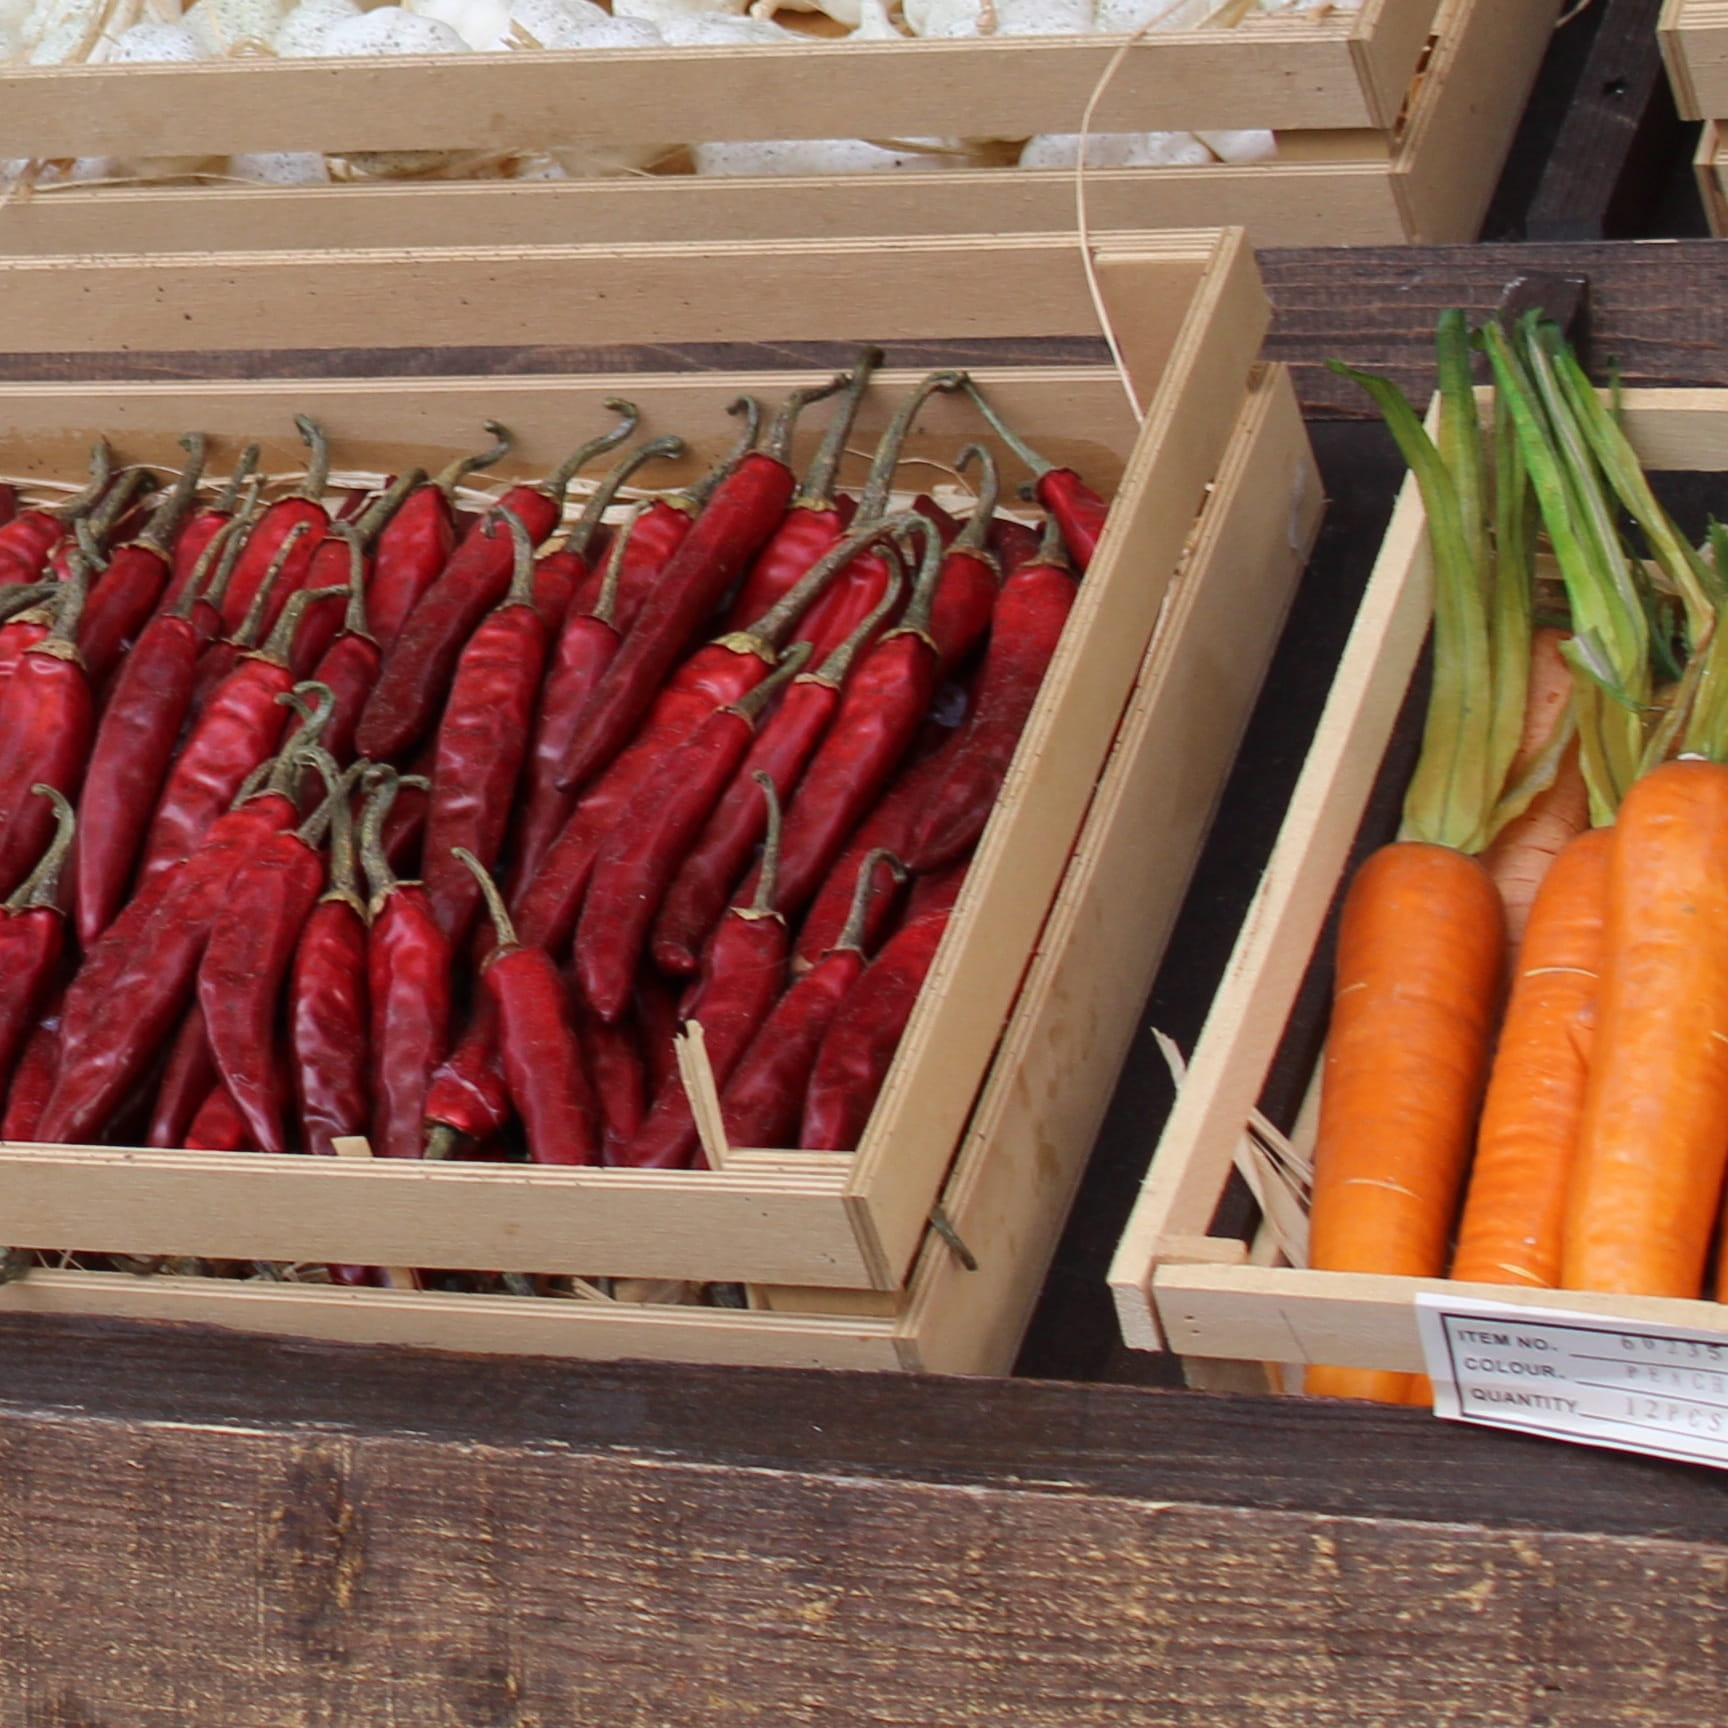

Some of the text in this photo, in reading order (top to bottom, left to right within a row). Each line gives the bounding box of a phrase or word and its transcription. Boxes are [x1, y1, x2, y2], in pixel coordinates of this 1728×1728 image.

[1457, 1329, 1511, 1346] ITEM
[1516, 1336, 1558, 1351] NO.
[1464, 1357, 1566, 1379] COLOUR.
[1471, 1387, 1723, 1432] QUANTITY 12PCS
